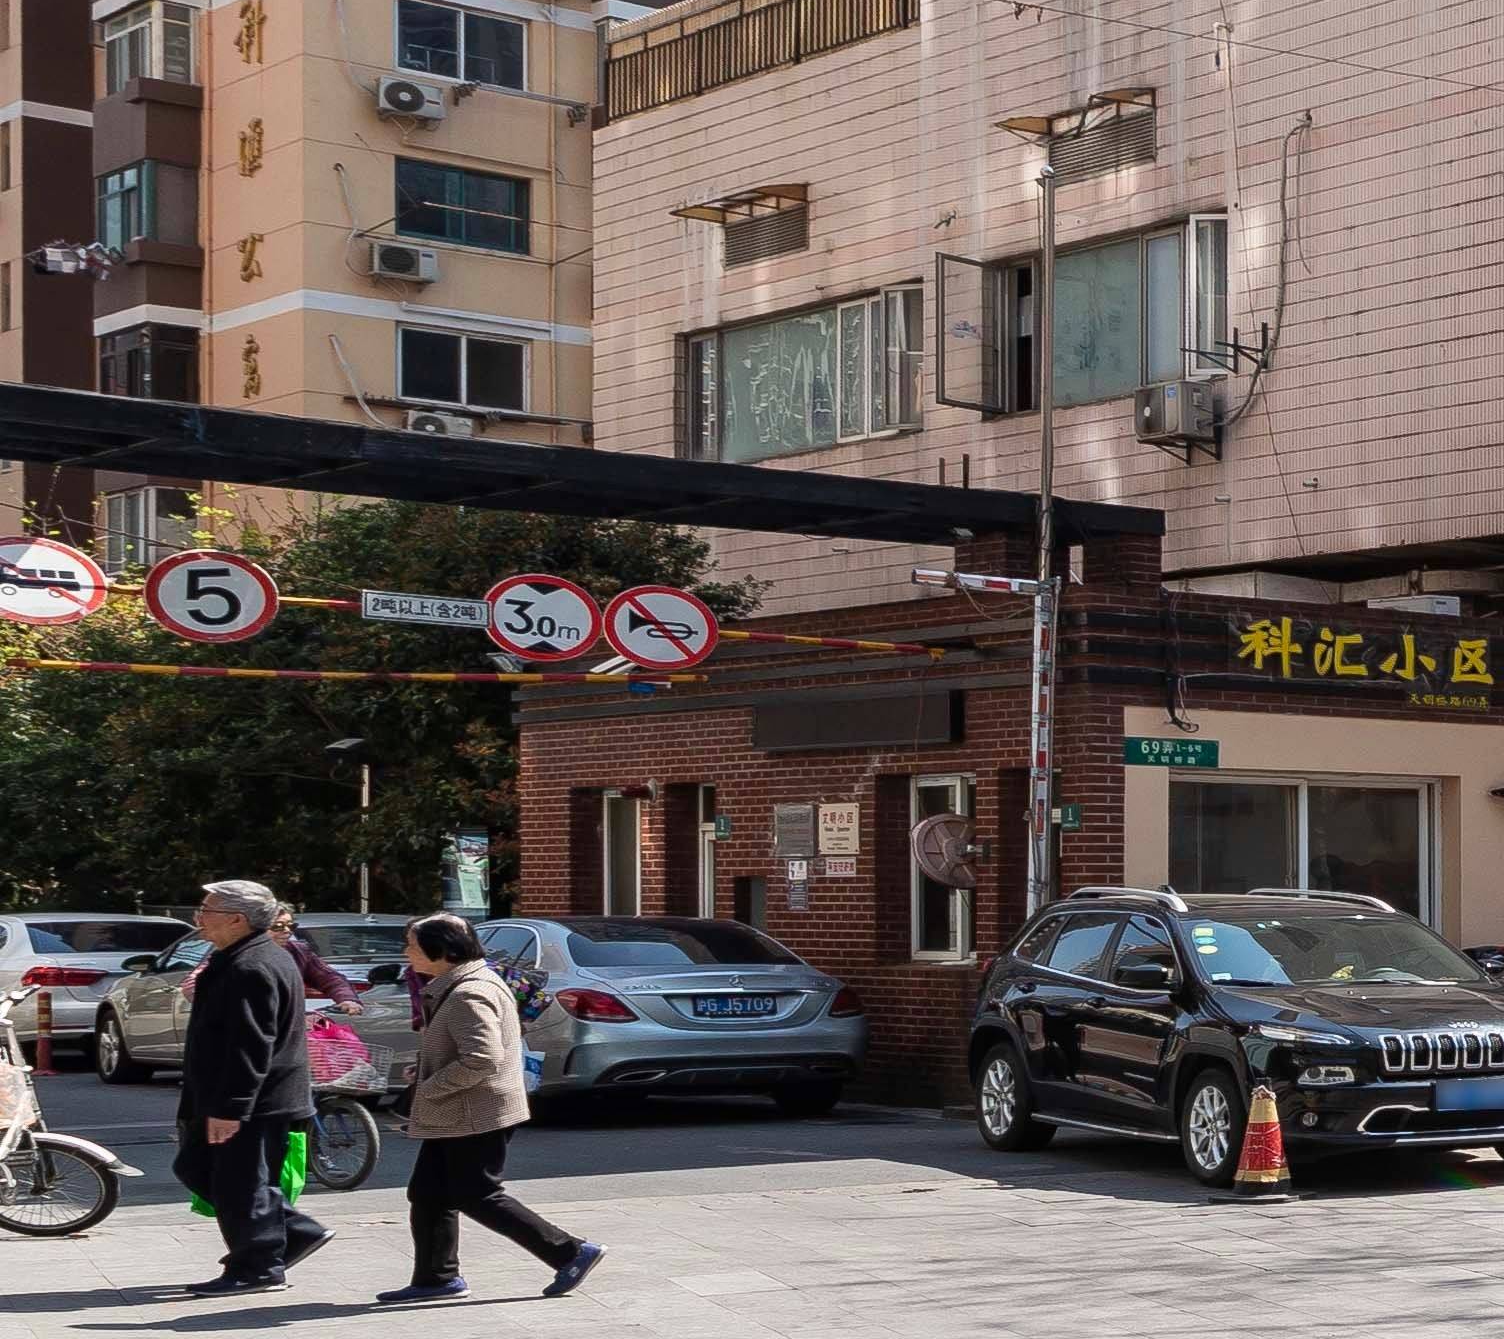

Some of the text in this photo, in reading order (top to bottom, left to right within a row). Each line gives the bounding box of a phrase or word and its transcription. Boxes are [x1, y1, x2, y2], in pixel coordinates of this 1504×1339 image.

[184, 568, 242, 626] 5
[1237, 616, 1494, 685] 科汇小区
